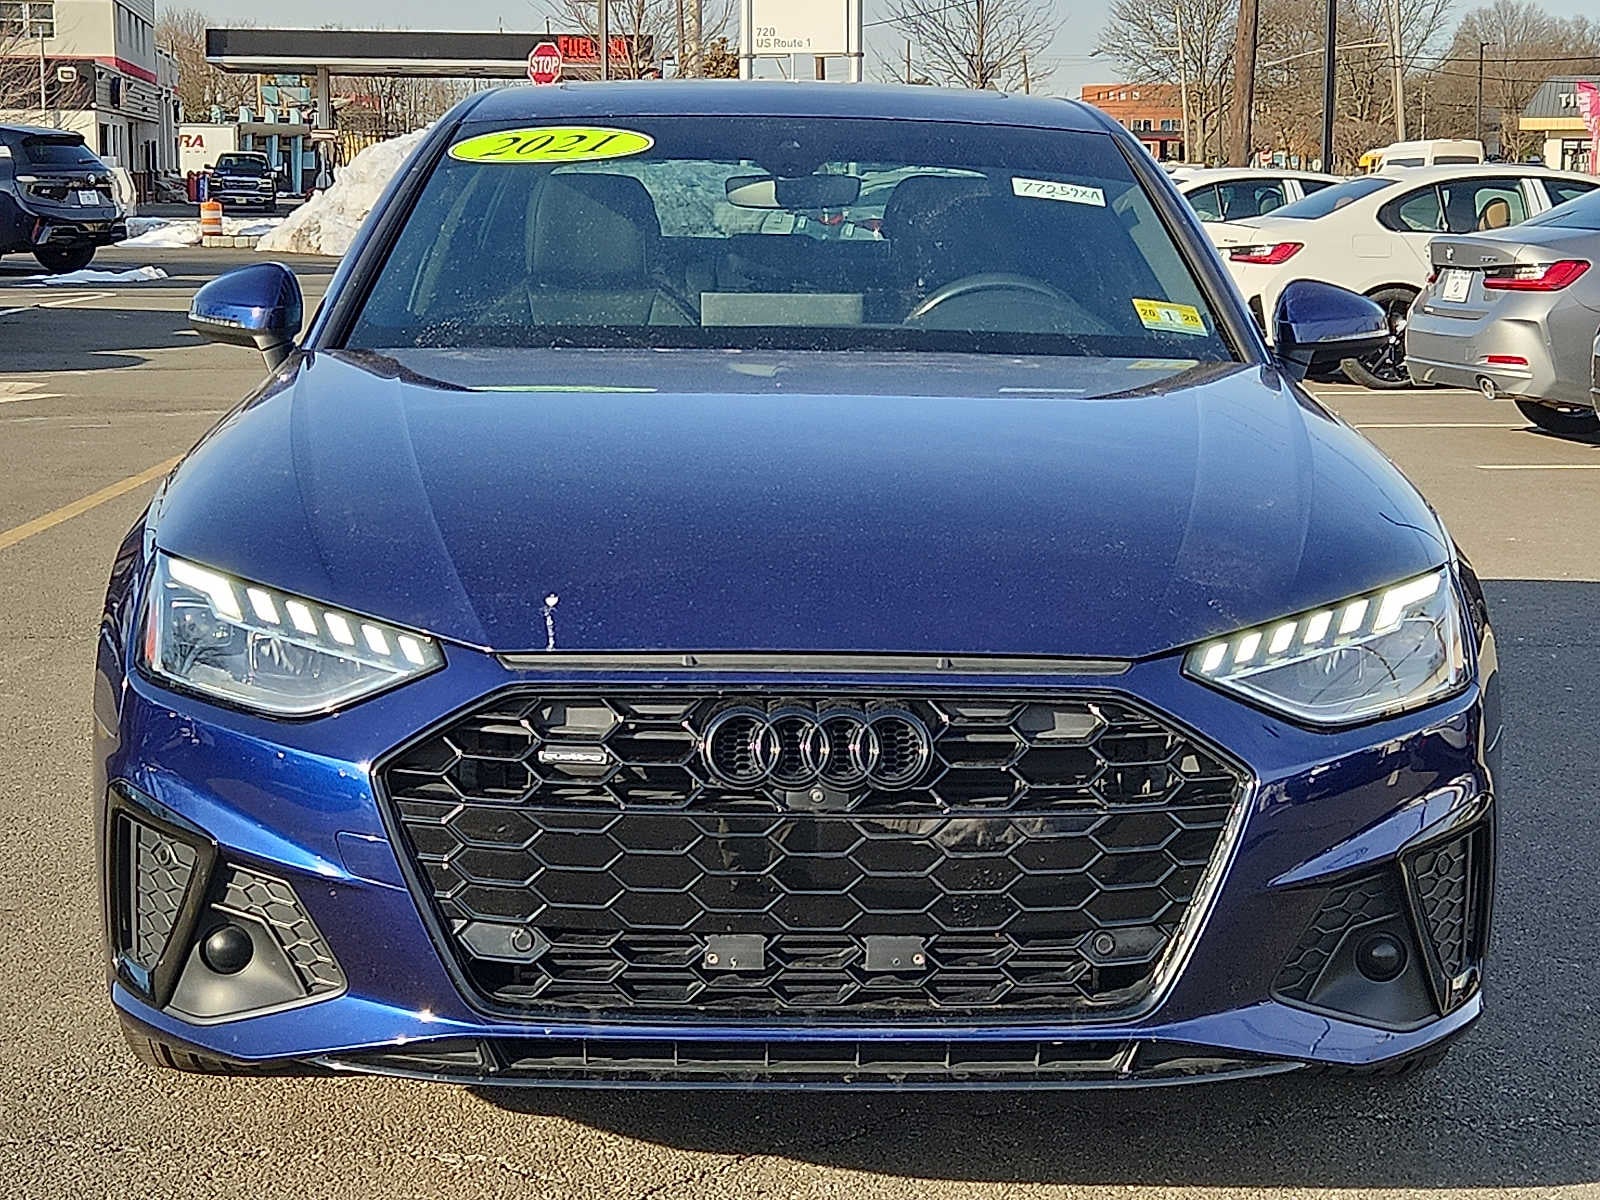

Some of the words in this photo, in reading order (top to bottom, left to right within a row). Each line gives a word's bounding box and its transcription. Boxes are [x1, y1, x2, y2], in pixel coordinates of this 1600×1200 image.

[756, 27, 776, 37] 720
[756, 38, 771, 48] US
[774, 38, 803, 48] Route
[806, 38, 811, 48] 1
[530, 56, 560, 74] STOP
[480, 134, 618, 157] 2021
